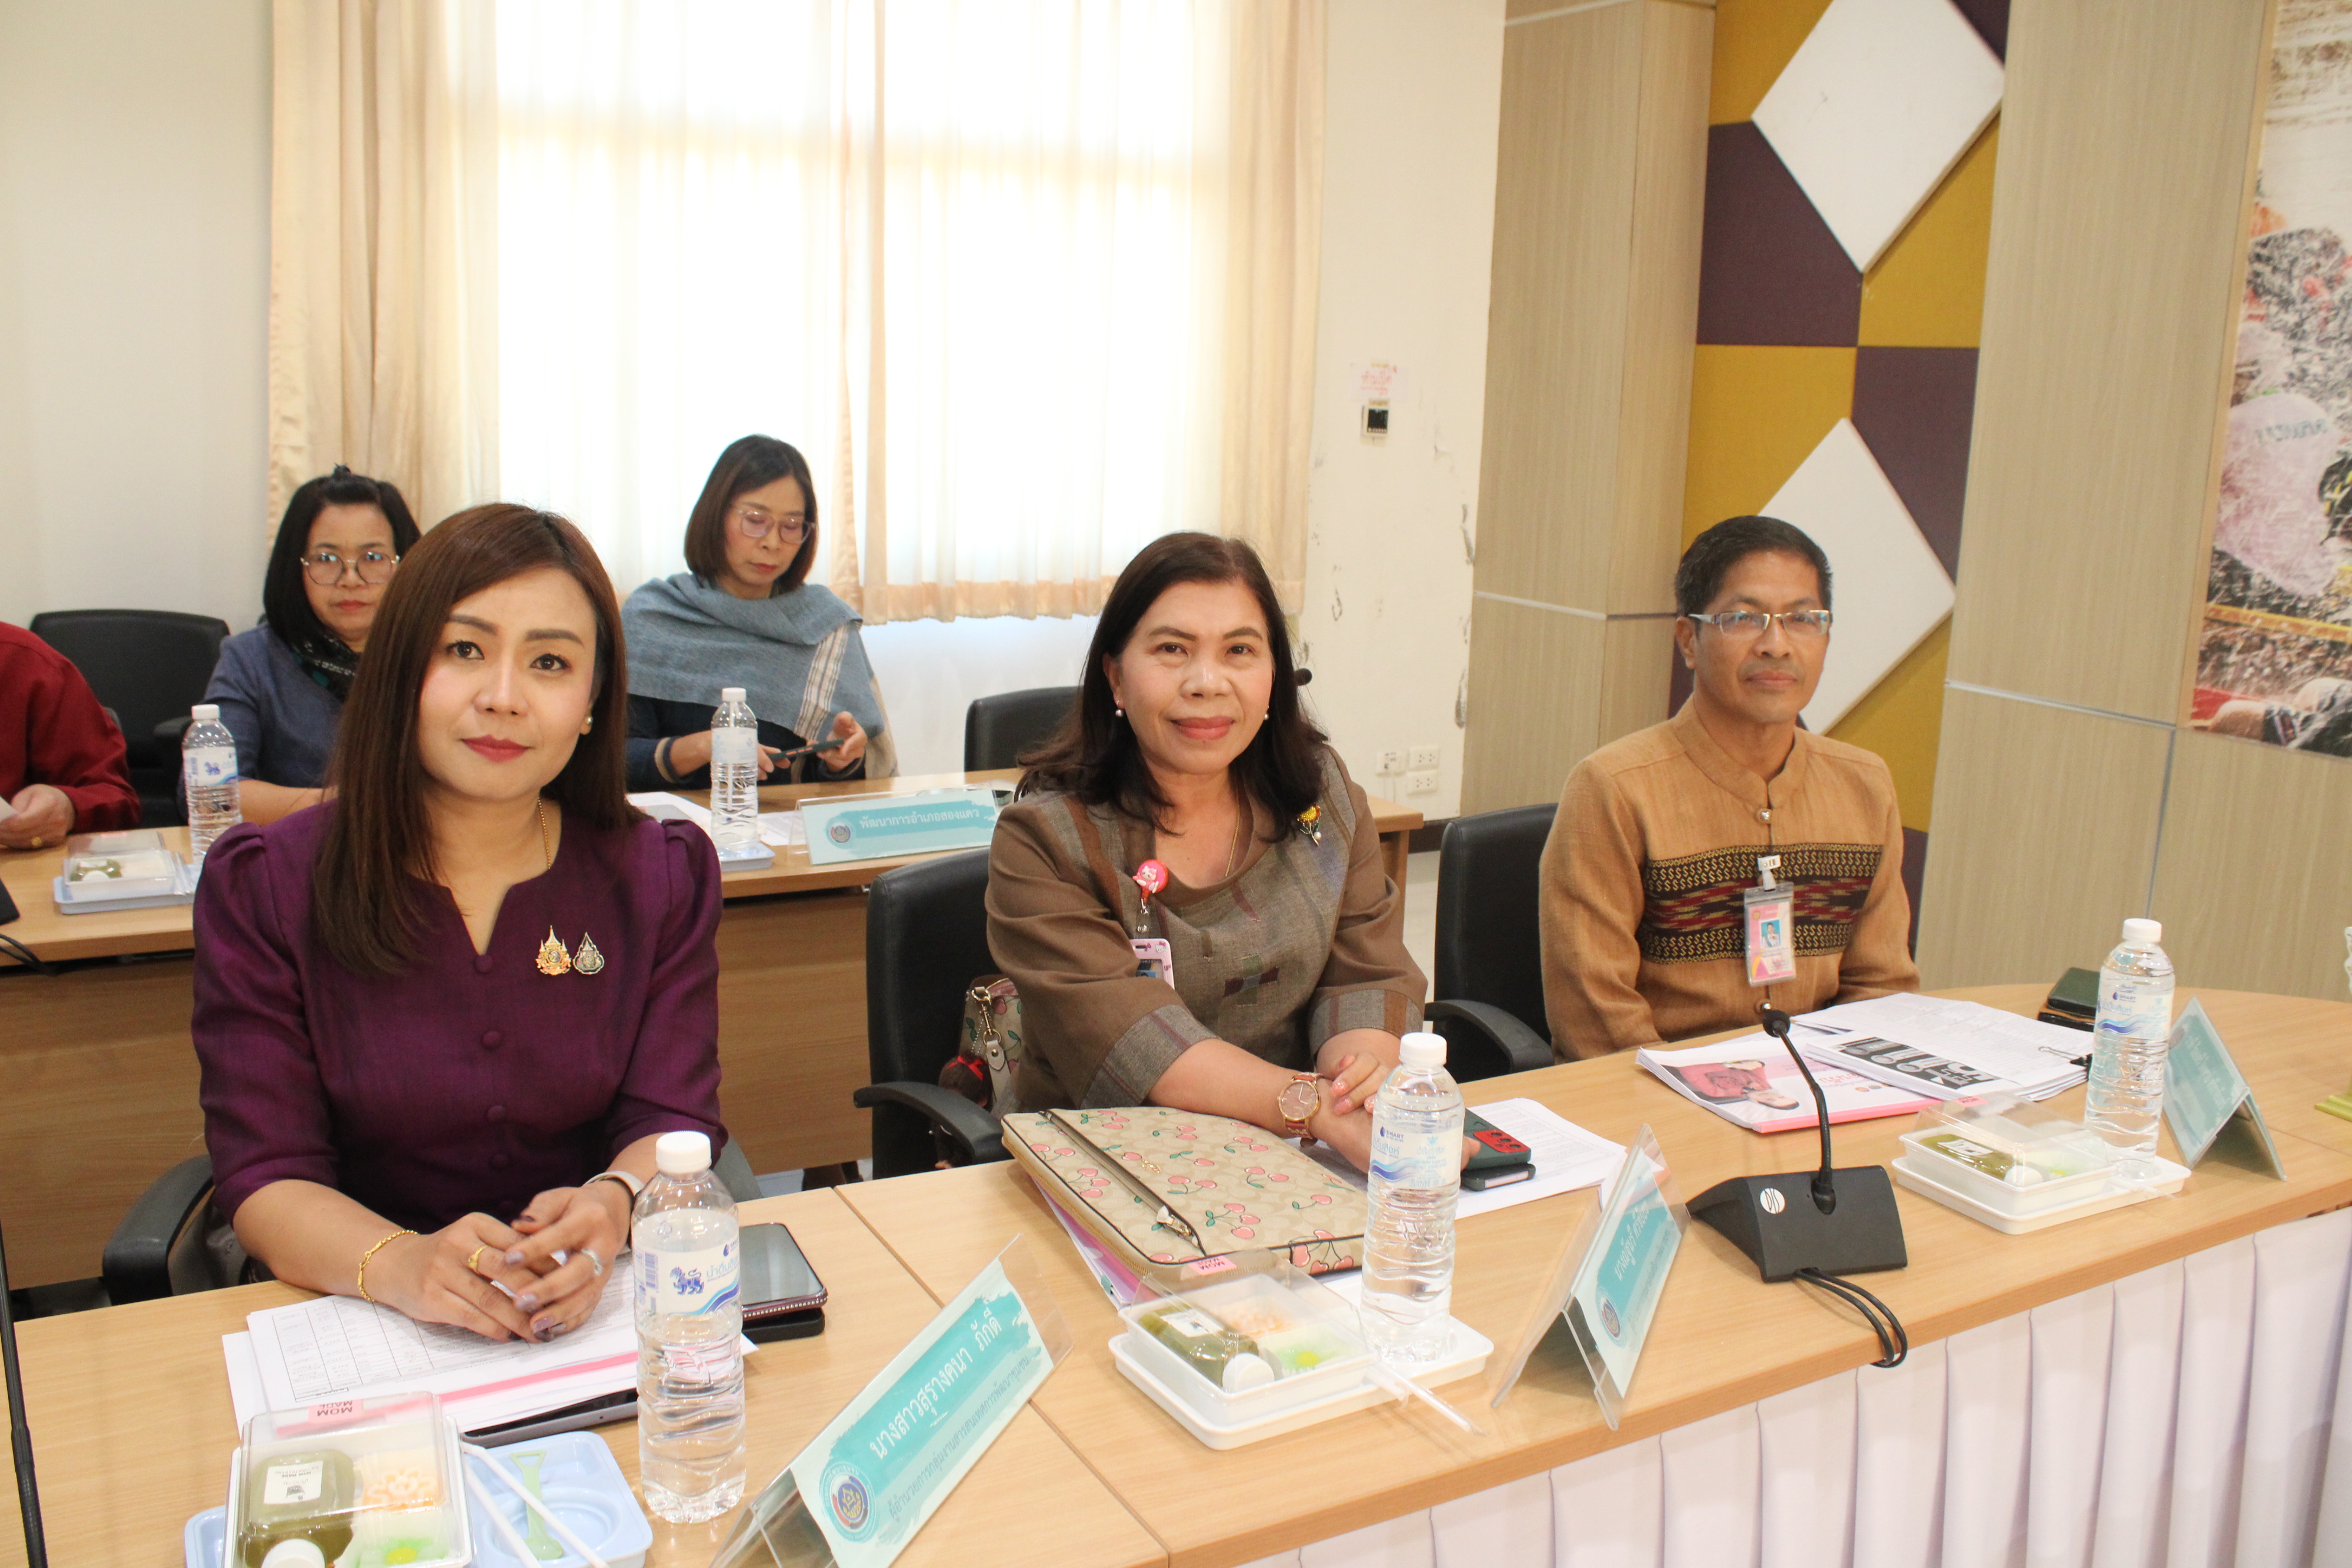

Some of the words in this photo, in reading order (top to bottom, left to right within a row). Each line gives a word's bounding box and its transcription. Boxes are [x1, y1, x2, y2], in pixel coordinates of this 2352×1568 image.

[860, 808, 979, 829] พัฒนาการอำเภอสองแคว
[1387, 1130, 1404, 1139] SMART
[1199, 1260, 1226, 1270] MOM
[870, 1347, 974, 1459] นางสาวสุรางคนา
[971, 1308, 1002, 1352] ภักดี
[317, 1407, 352, 1416] MOM
[888, 1354, 1030, 1523] ผู้อำนวยการกลุ่มงานสารสนเทศการพัฒนาชุมชน
